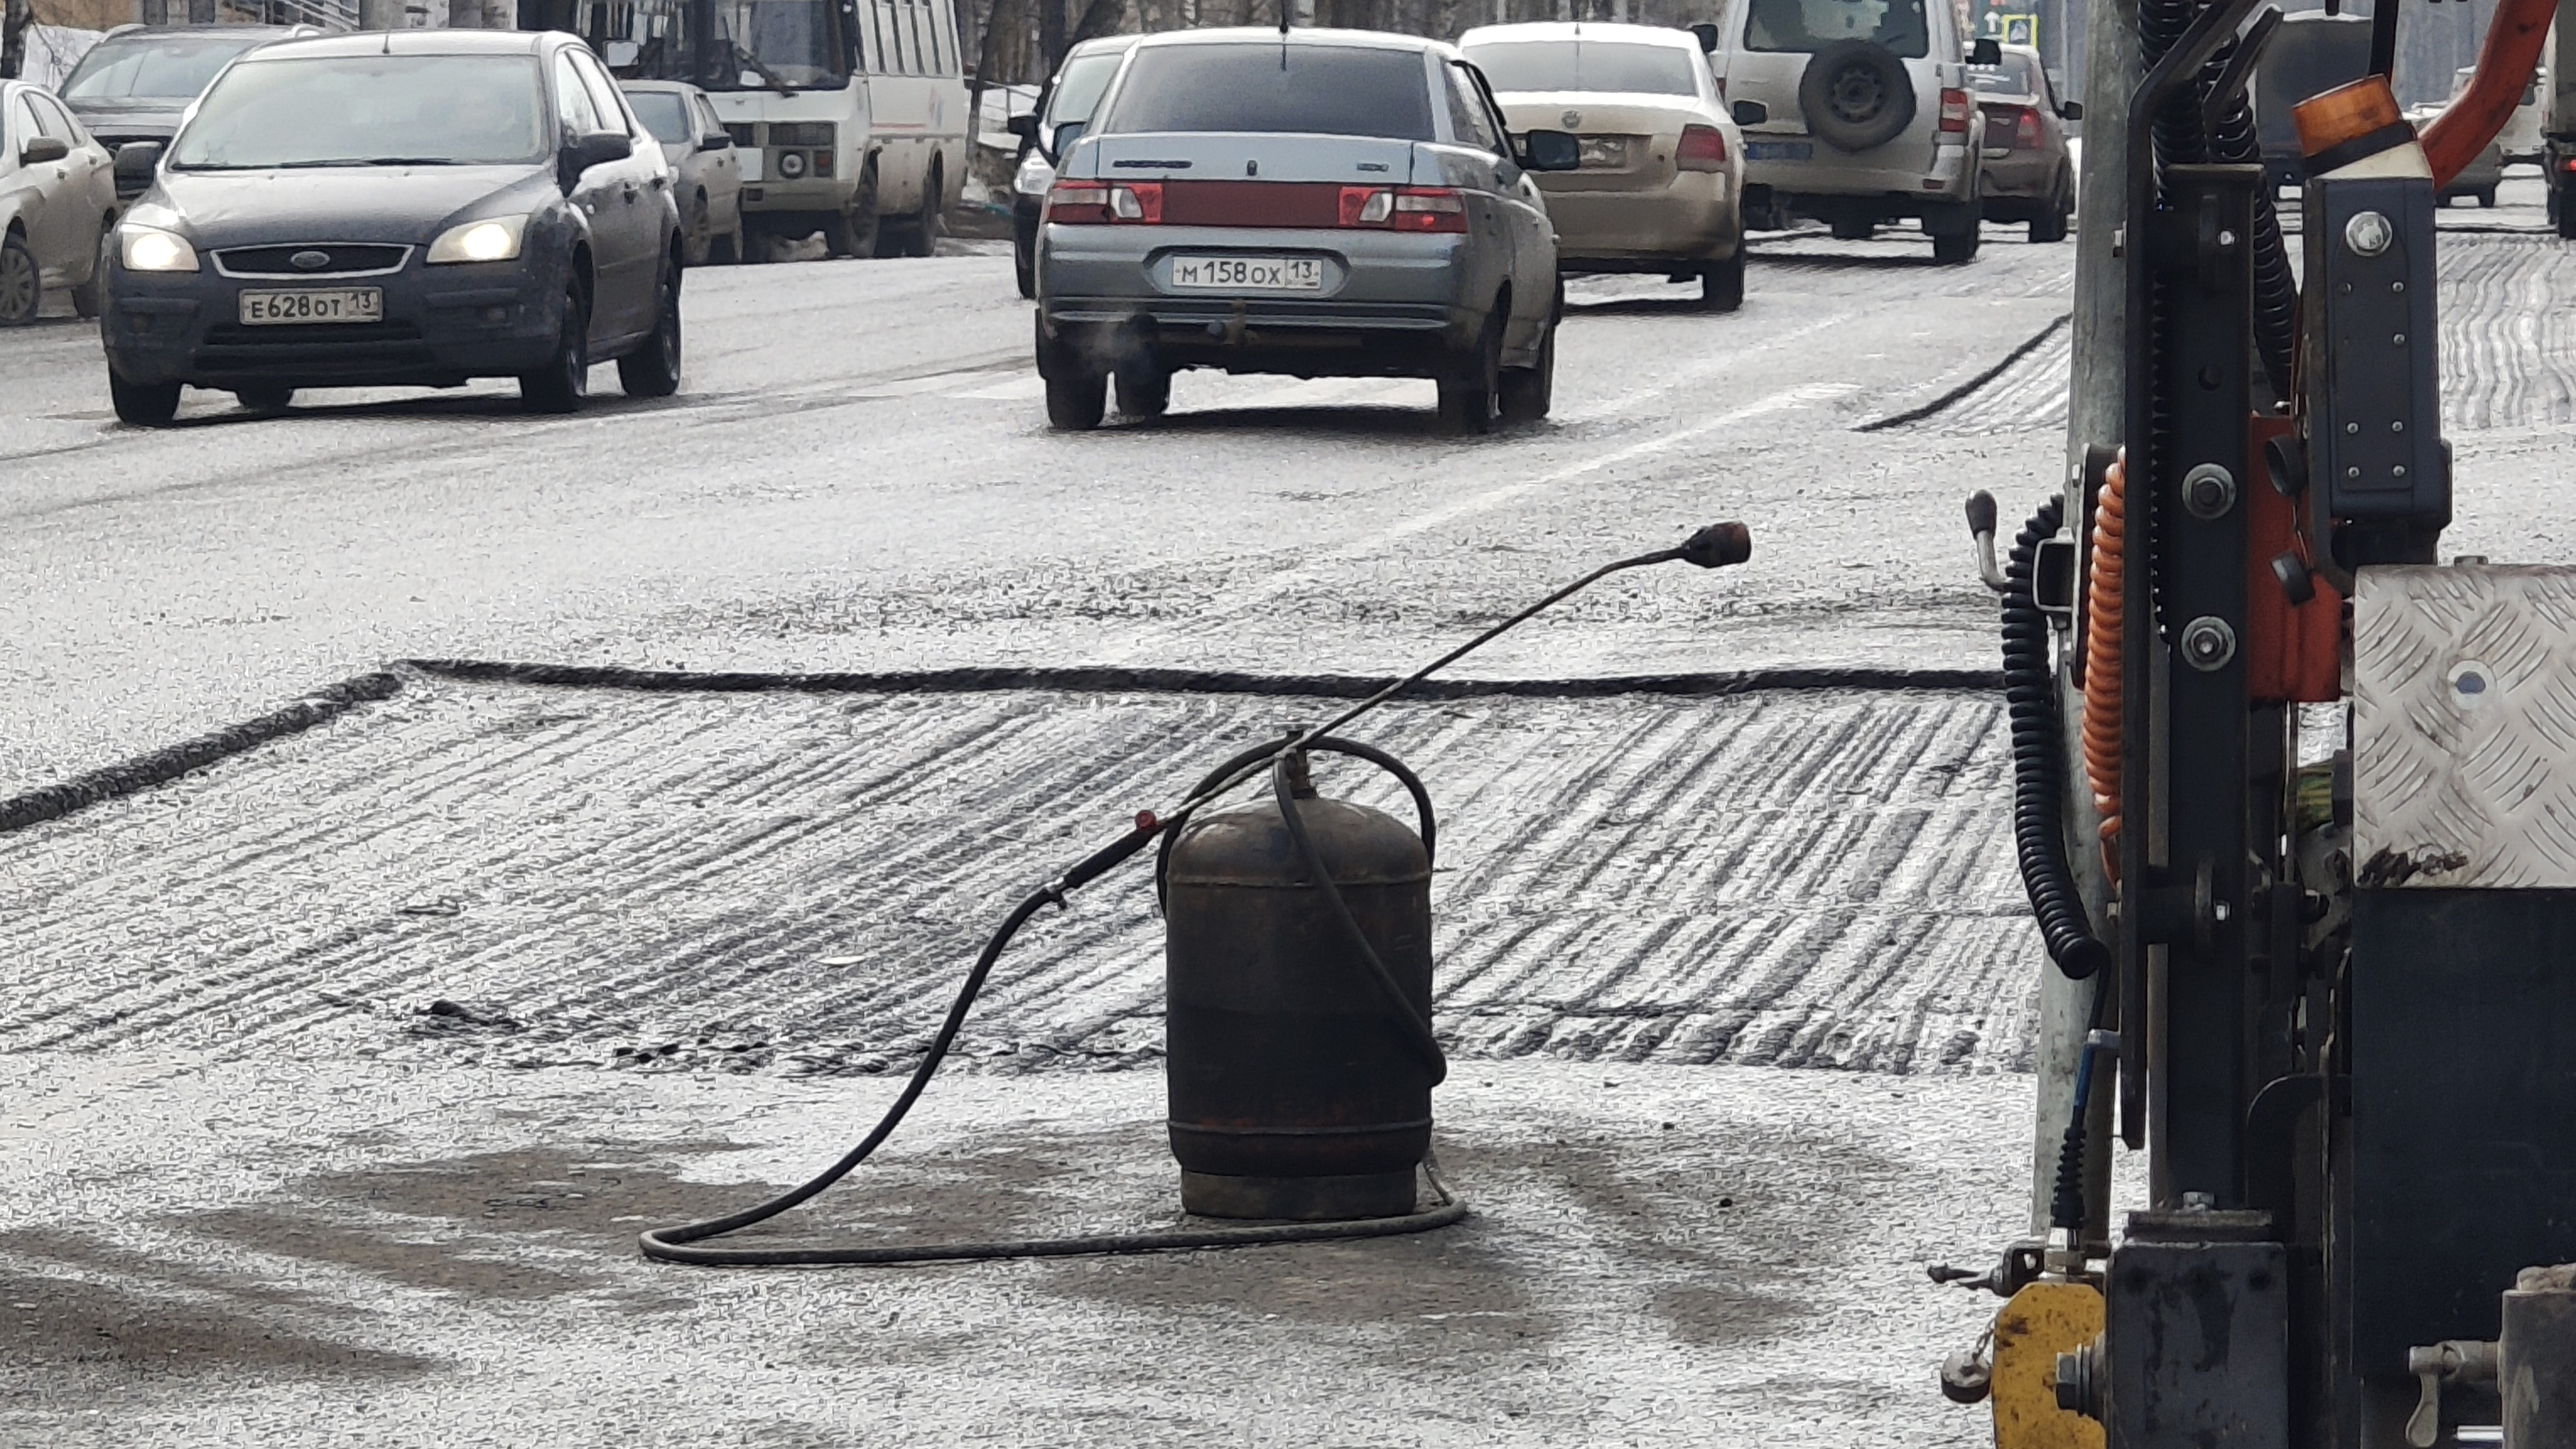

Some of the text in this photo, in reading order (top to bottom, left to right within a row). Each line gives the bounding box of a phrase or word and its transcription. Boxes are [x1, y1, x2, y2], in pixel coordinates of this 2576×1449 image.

[1181, 261, 1313, 284] М158ОХ 13
[251, 292, 371, 318] Е628ОТ 13
